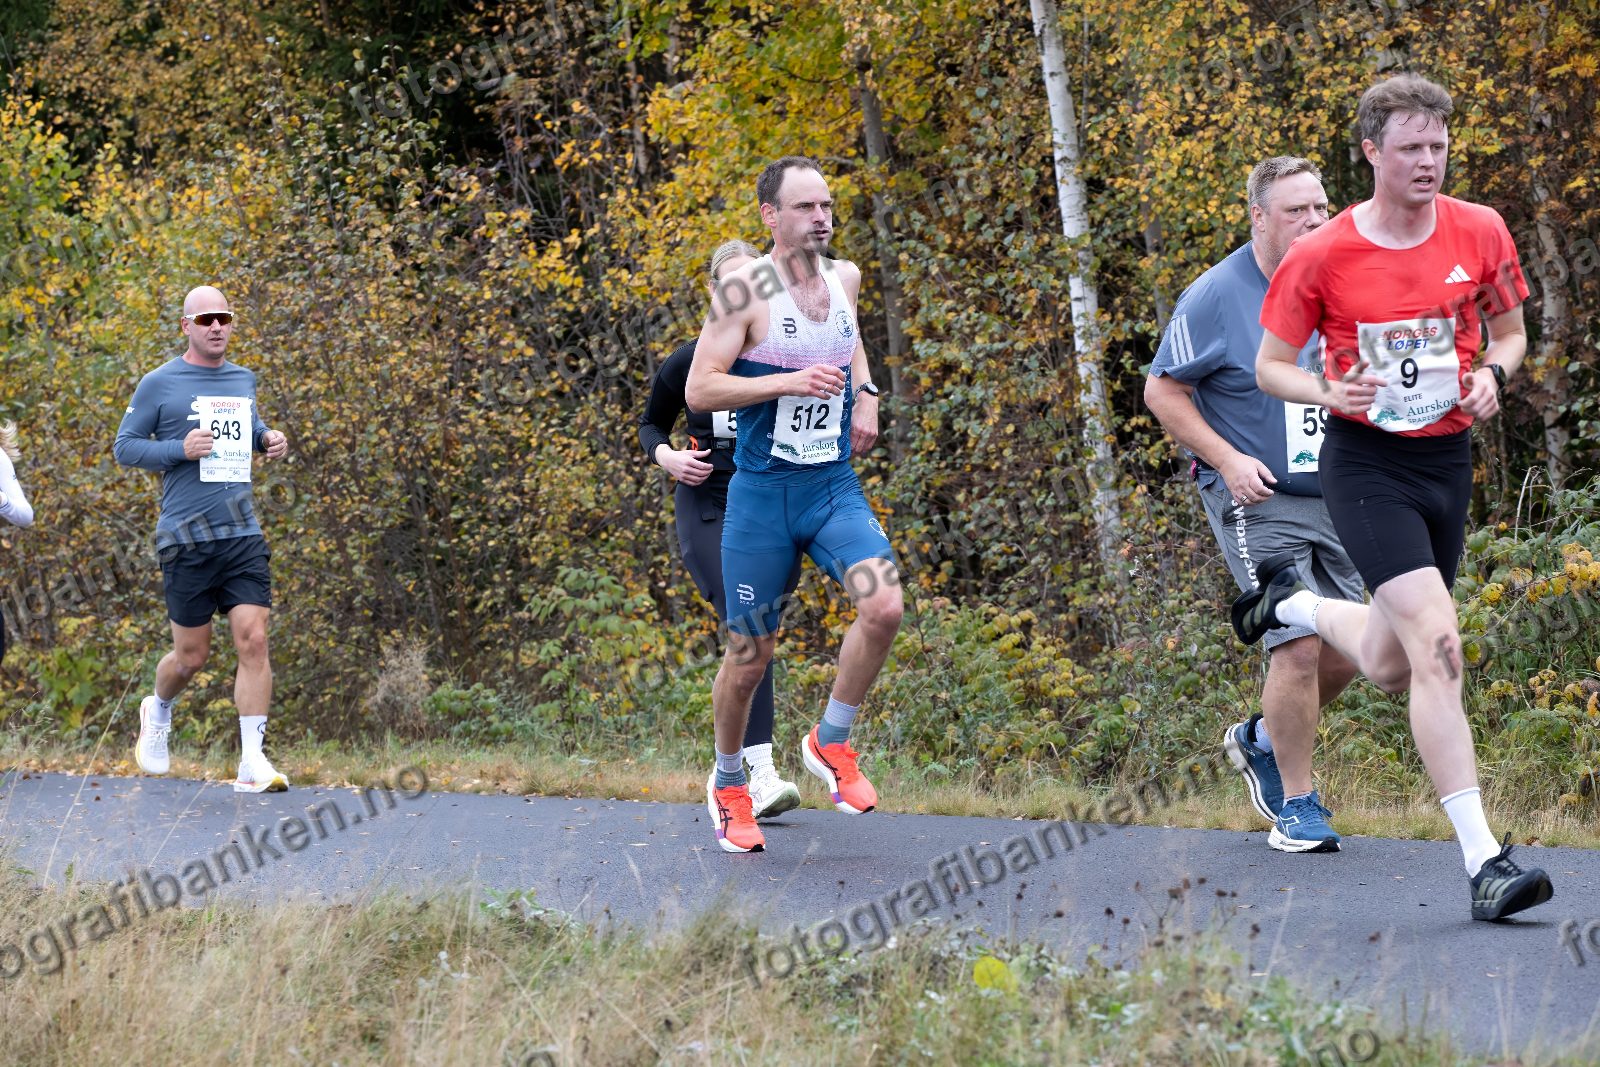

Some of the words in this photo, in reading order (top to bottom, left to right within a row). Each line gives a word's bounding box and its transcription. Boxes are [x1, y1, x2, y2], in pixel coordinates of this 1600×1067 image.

[1384, 327, 1437, 340] NORGES
[1387, 338, 1429, 350] LØPET
[1400, 358, 1419, 388] 9
[1404, 393, 1423, 402] ELITE
[1407, 397, 1458, 416] Aurskog
[790, 403, 830, 432] 512
[210, 420, 241, 440] 643
[801, 440, 836, 453] Aurskog
